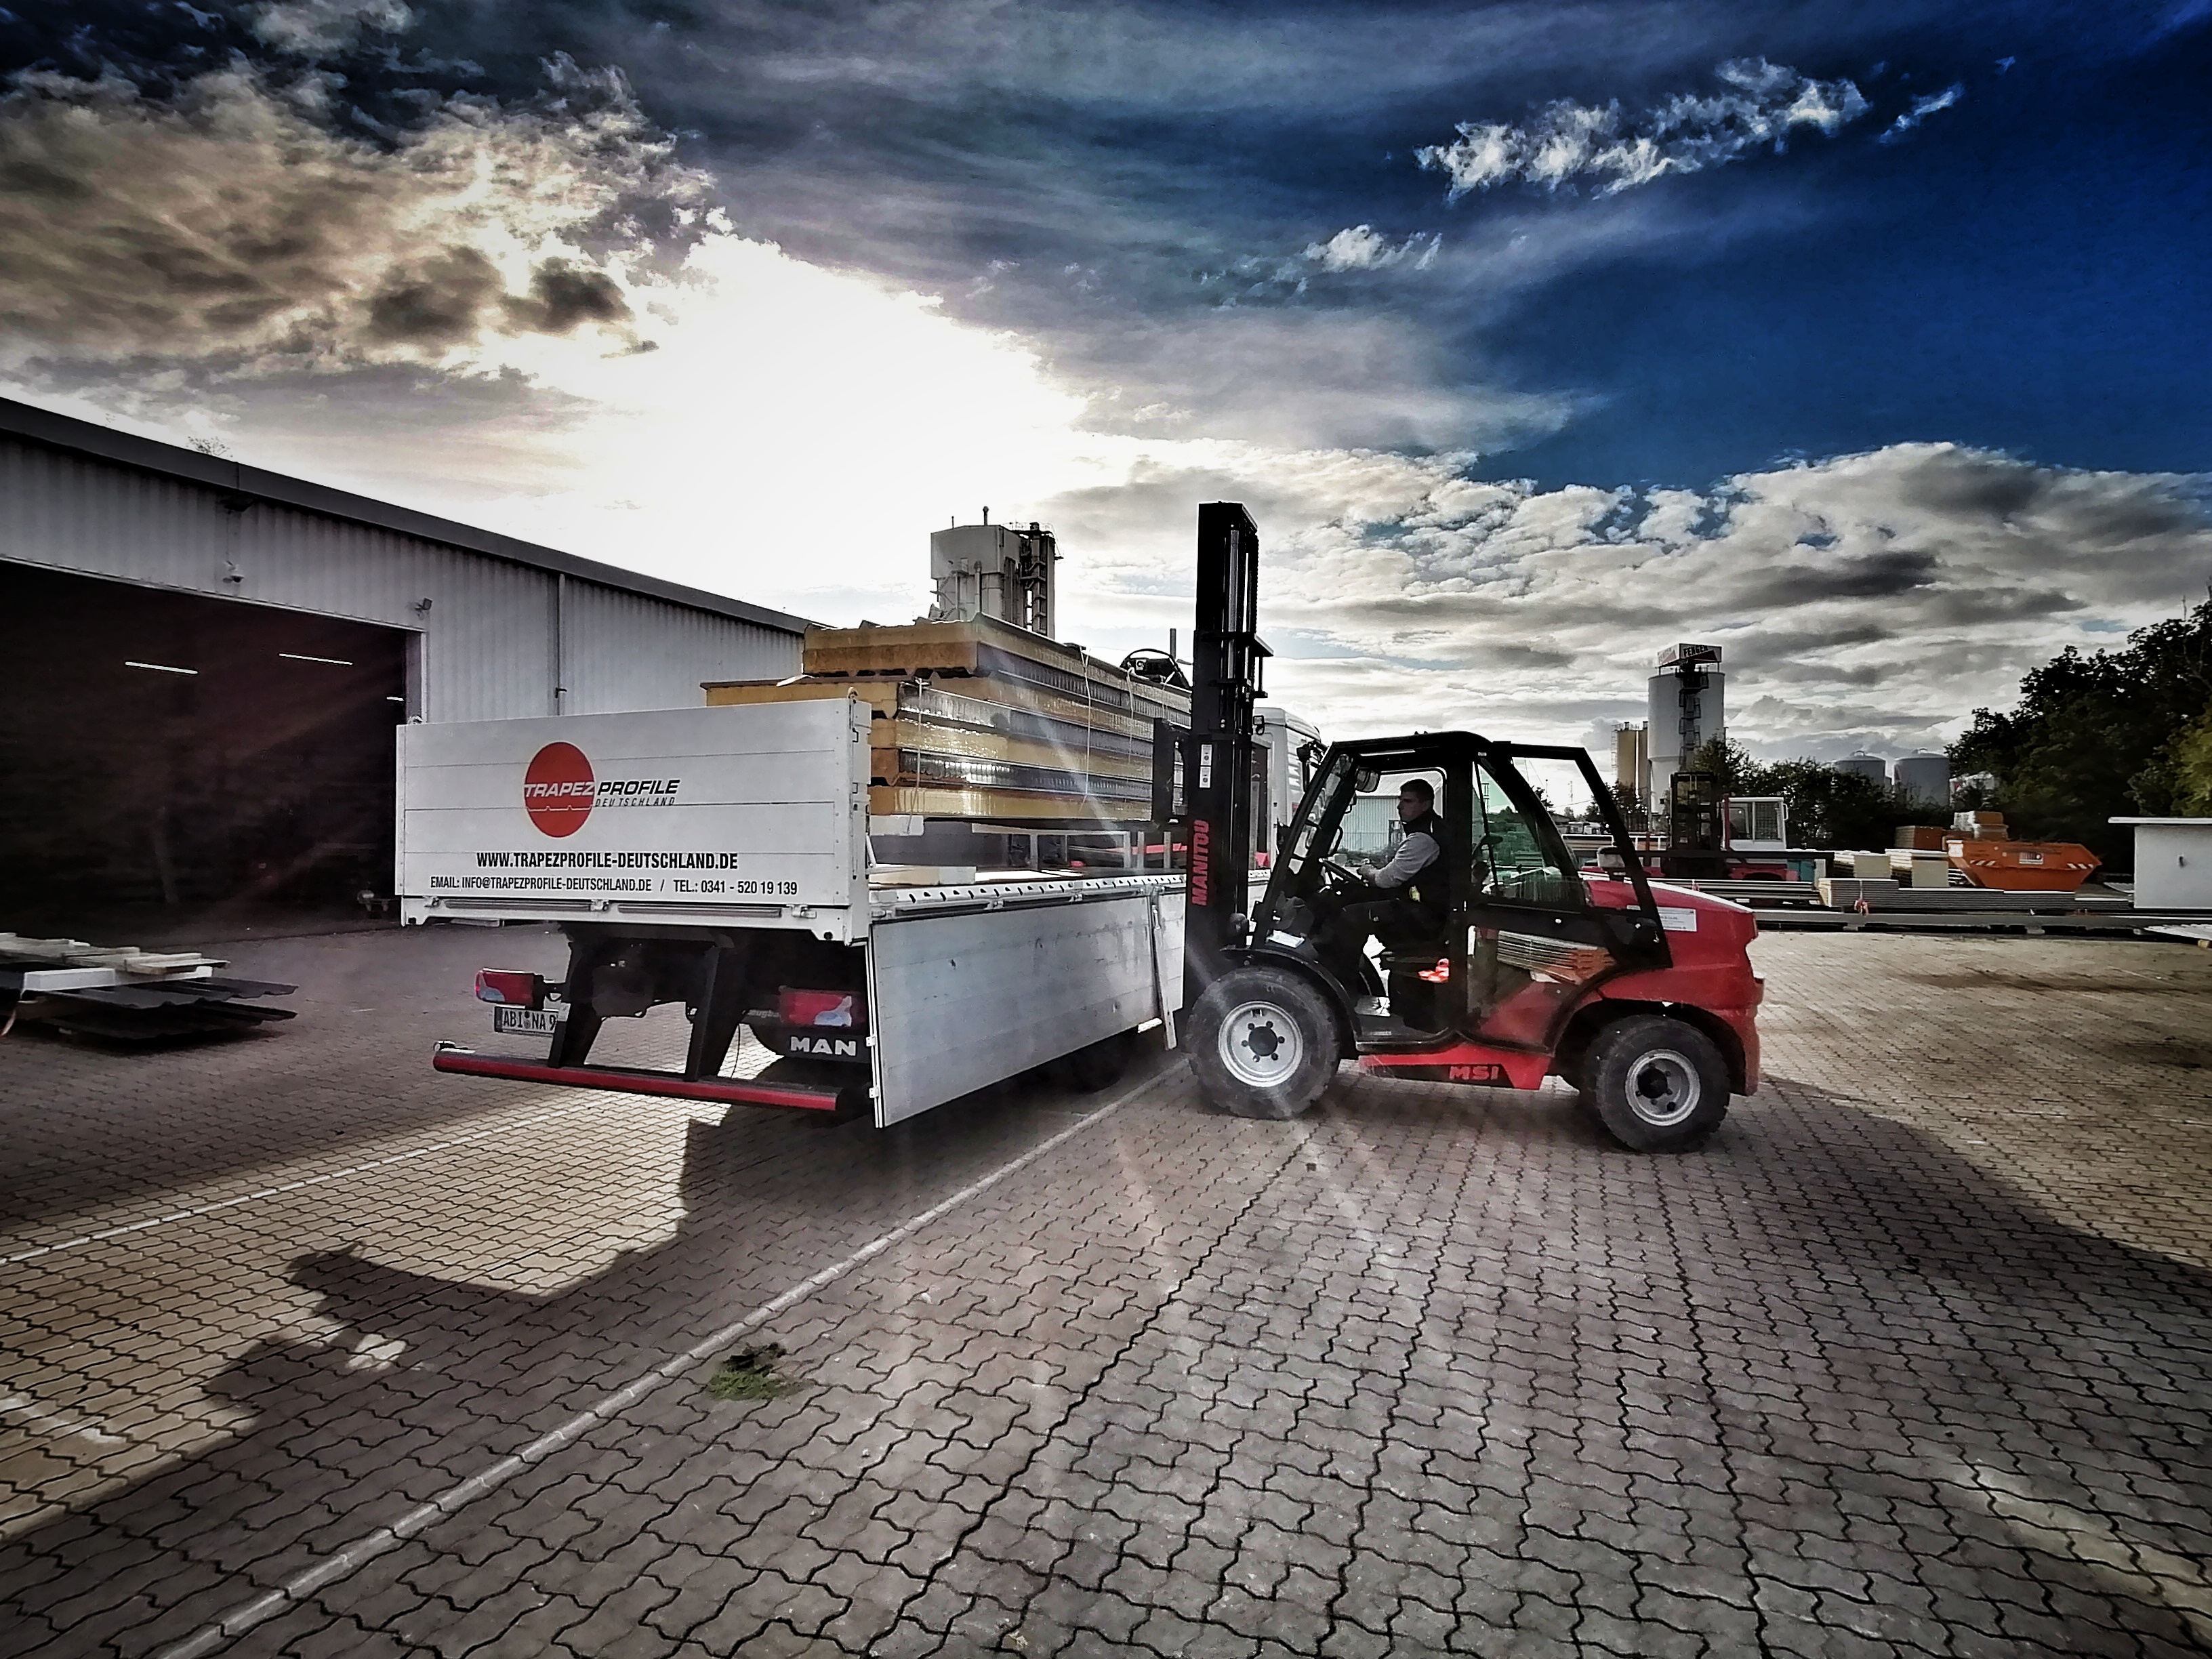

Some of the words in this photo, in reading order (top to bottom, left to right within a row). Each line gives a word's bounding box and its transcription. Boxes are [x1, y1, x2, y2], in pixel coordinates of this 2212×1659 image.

[524, 781, 594, 798] TRAPEZ
[597, 779, 680, 796] PROFILE
[595, 797, 676, 807] DEUTSCHLAND
[476, 852, 738, 869] WWW.TRAPEZPROFILE-DEUTSCHLAND.DE
[1191, 819, 1210, 906] MANITOU
[430, 876, 459, 888] EMAIL:
[462, 877, 652, 892] INFO@TRAPEZPROFILE-DEUTSCHLAND.DE
[659, 879, 665, 892] /
[673, 880, 698, 893] TEL.:
[701, 880, 725, 893] 0341
[737, 881, 758, 894] 520
[760, 882, 774, 895] 19
[777, 882, 798, 895] 139
[503, 1011, 523, 1028] ABI
[531, 1012, 546, 1031] NA
[790, 1036, 856, 1057] MAN
[1449, 1065, 1500, 1080] MSI
